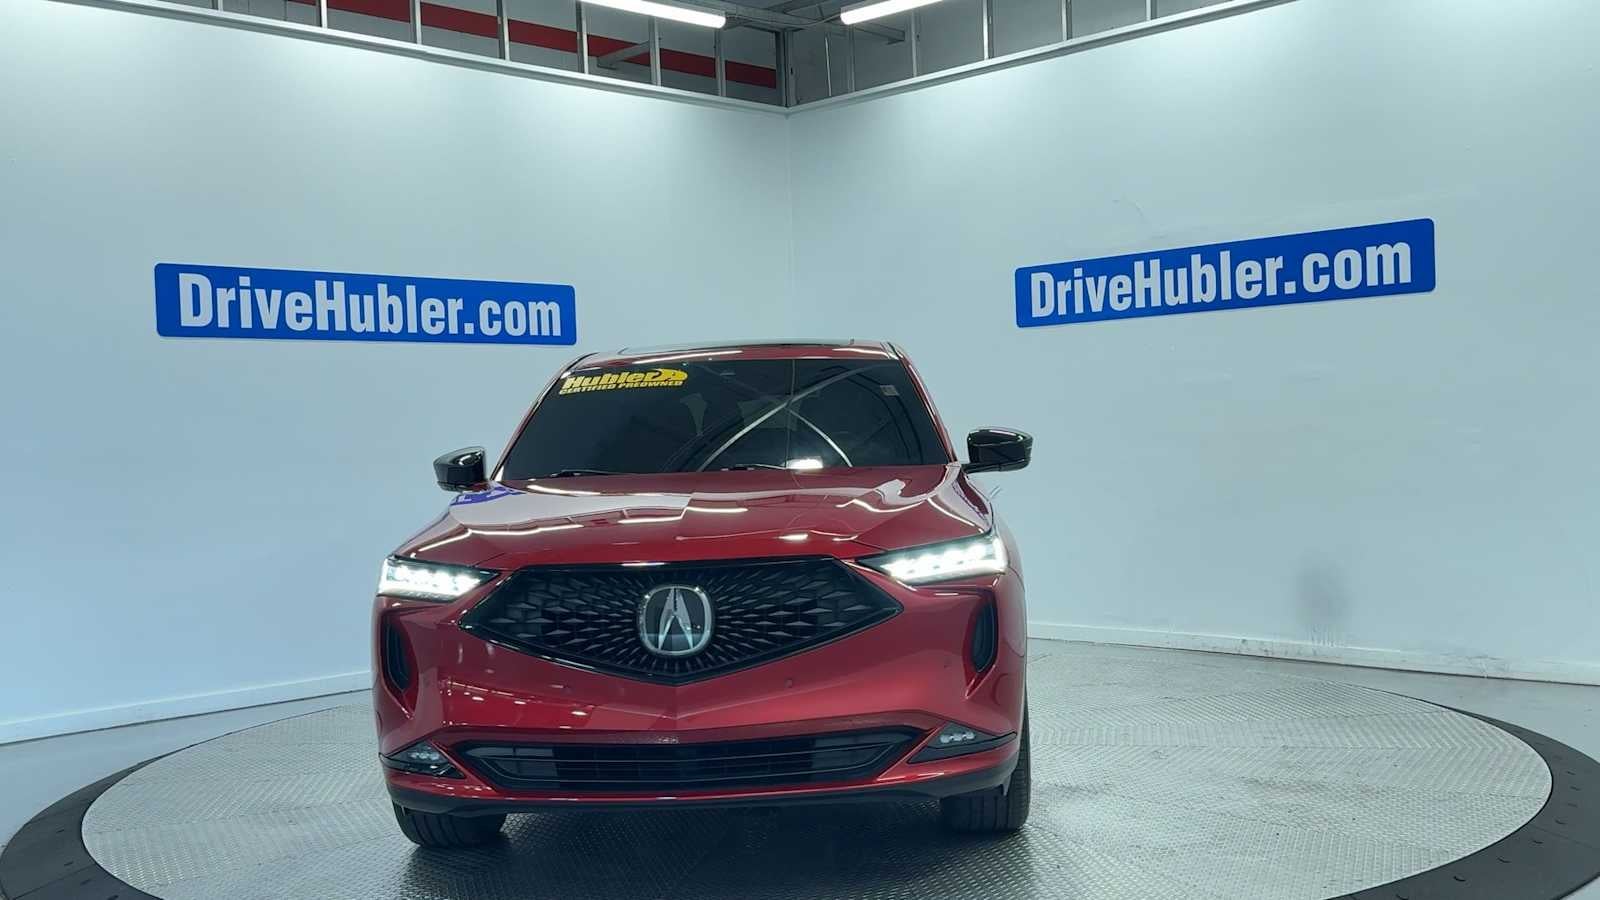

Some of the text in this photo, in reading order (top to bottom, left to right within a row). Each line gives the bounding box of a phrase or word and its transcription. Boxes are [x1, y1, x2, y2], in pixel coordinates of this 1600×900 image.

[1030, 240, 1412, 319] DriveHubler.com
[178, 272, 562, 337] DriveHubler.com
[559, 383, 617, 395] CERTIFIED
[561, 370, 664, 390] Hubler
